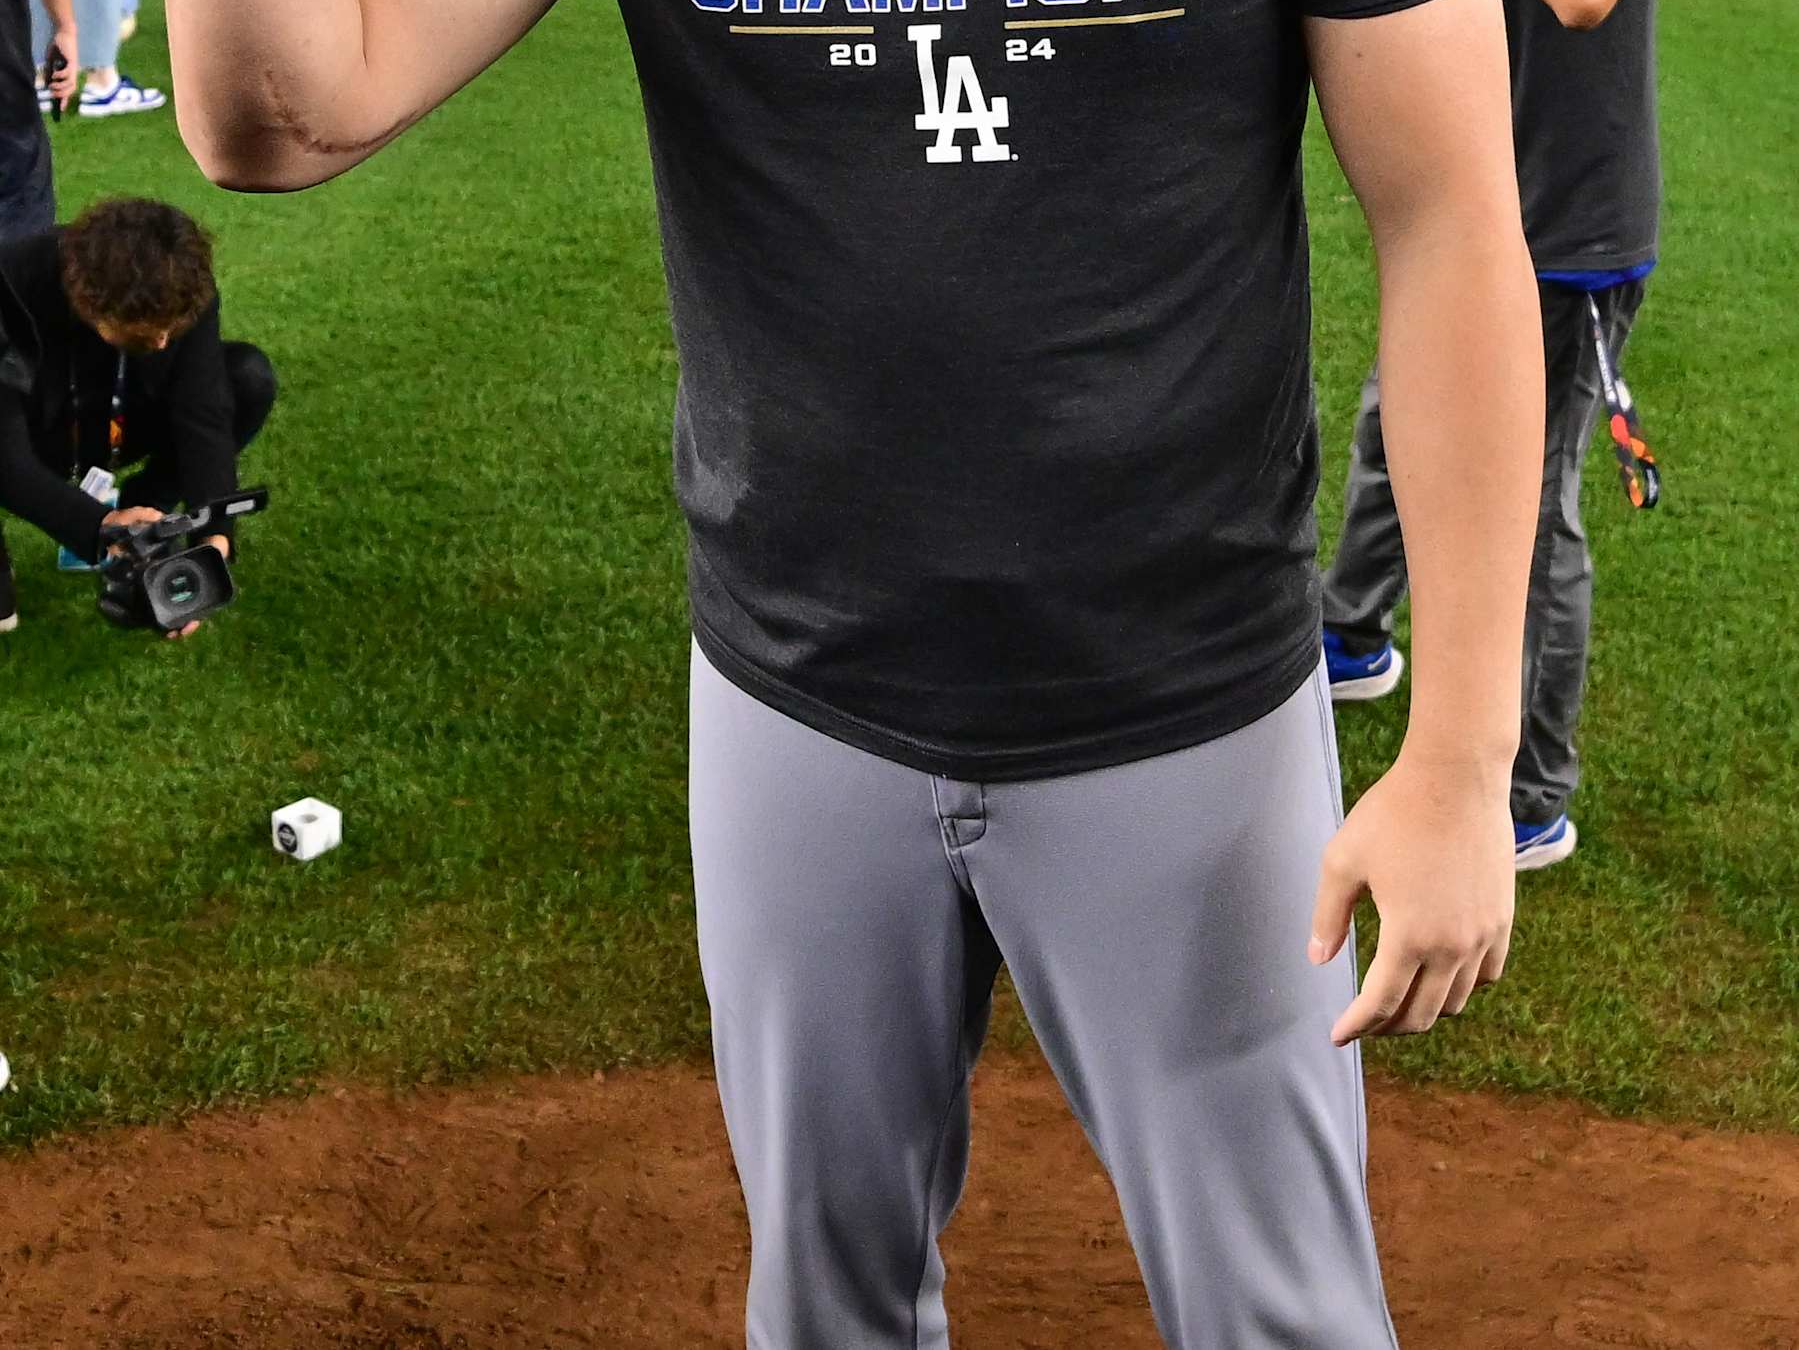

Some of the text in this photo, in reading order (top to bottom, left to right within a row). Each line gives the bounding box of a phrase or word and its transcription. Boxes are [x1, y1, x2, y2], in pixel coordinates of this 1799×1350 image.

[829, 38, 1056, 67] 20 24
[907, 24, 1010, 163] LA
